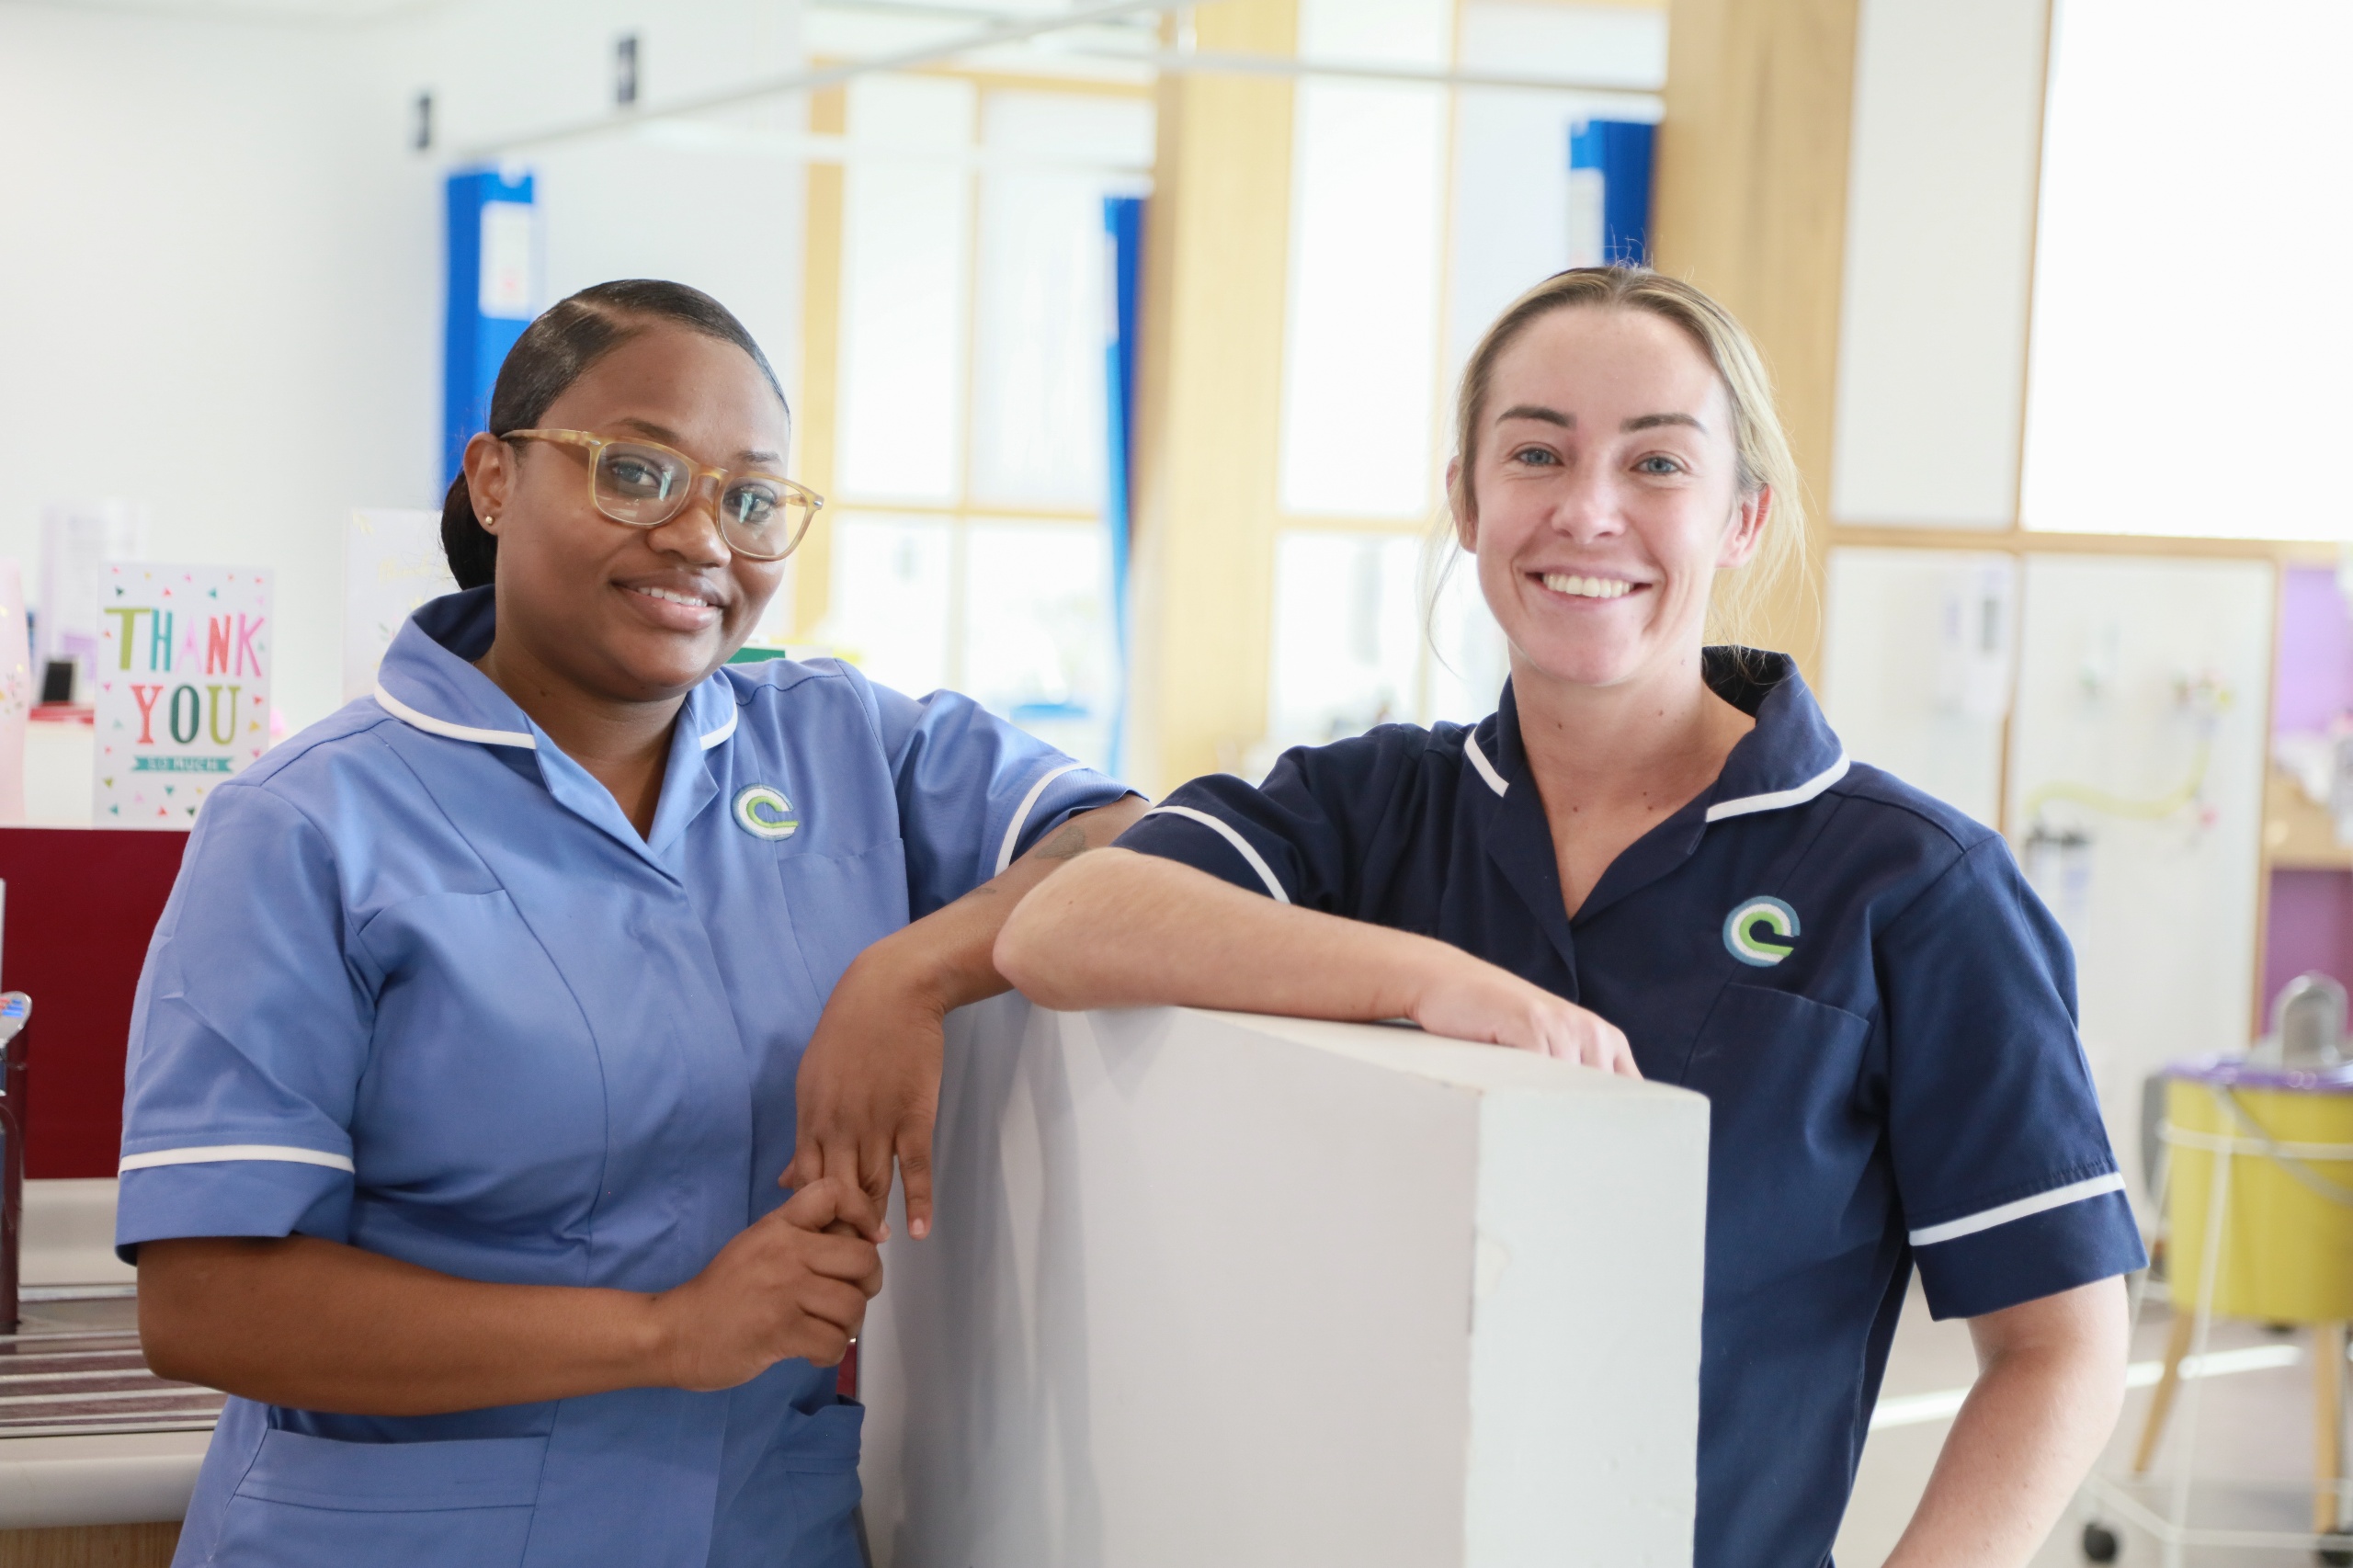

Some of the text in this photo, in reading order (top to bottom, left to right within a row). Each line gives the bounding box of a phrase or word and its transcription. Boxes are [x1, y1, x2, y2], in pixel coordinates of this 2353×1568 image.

[104, 608, 265, 676] THANK
[130, 684, 241, 745] YOU
[173, 756, 218, 772] MUCH
